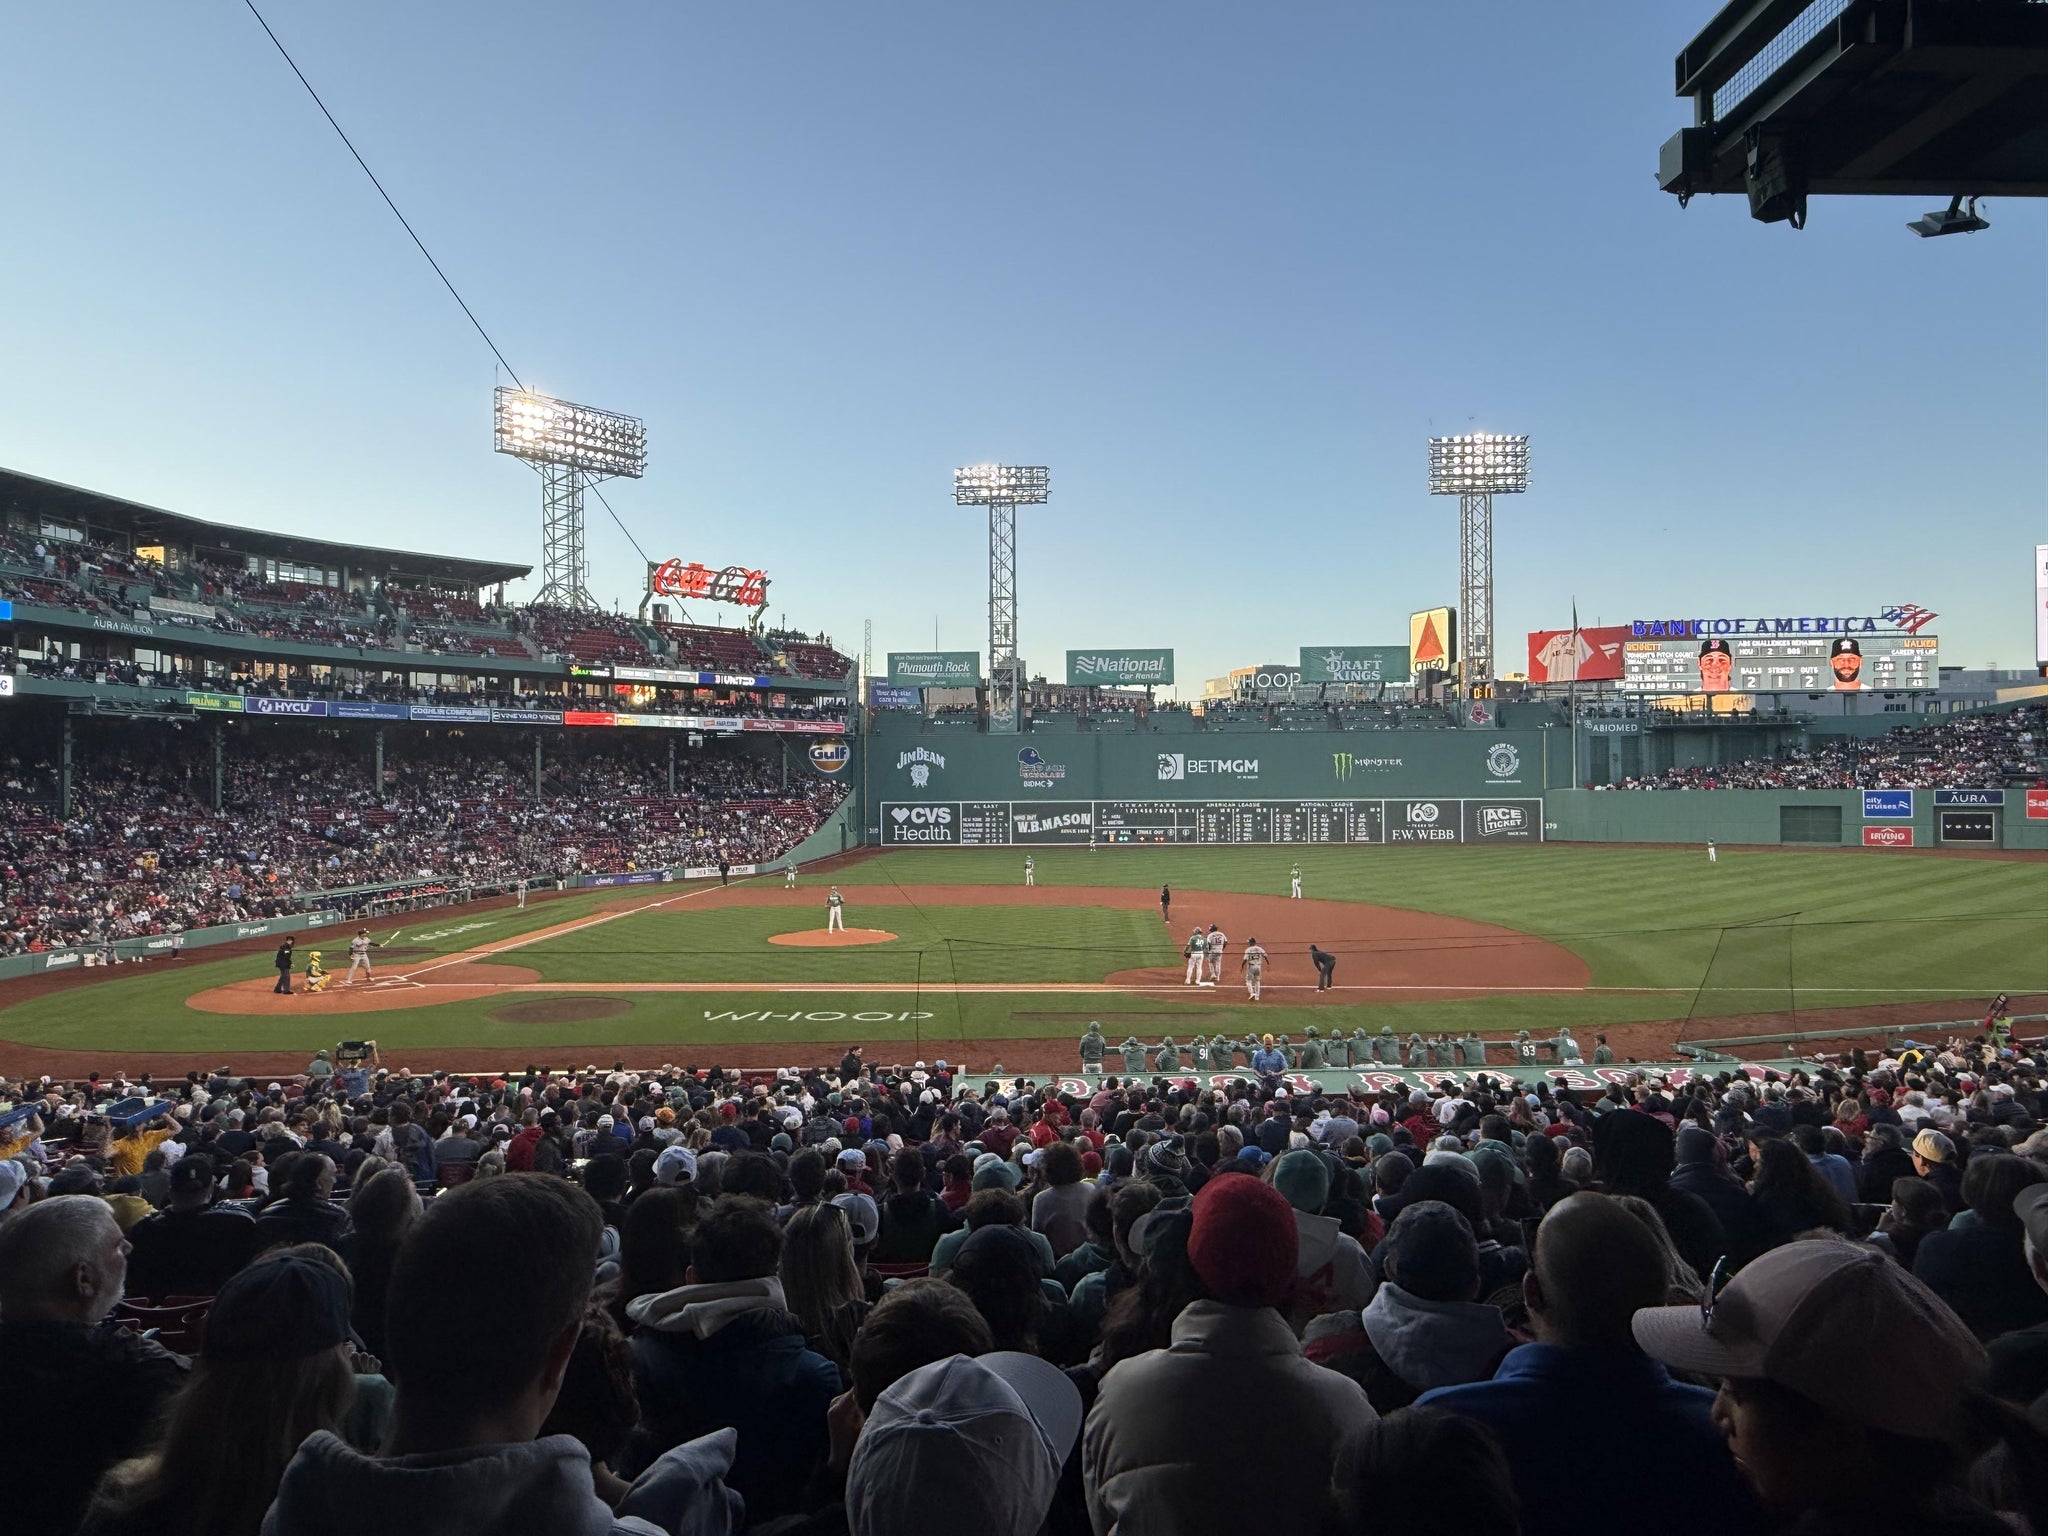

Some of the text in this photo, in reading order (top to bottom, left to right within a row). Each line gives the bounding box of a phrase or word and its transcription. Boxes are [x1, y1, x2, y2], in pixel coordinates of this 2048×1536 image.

[120, 622, 153, 635] PAVILION
[1632, 616, 1876, 635] BANK OF AMERICA
[1903, 640, 1936, 648] WALKER
[897, 662, 970, 674] Plymouth Rock
[1096, 657, 1165, 672] National
[1326, 659, 1382, 672] DRAFT
[1228, 672, 1300, 689] WHOOP
[1333, 670, 1381, 681] KINGS
[723, 678, 756, 686] UNITED
[1747, 676, 1814, 688] 2 1 2
[274, 701, 310, 712] HYCU
[1592, 724, 1638, 732] ABIOMED
[810, 745, 848, 759] Gulf
[896, 746, 946, 770] JIM BEAM
[1187, 758, 1259, 773] BETMGM
[1354, 758, 1403, 767] MONSTER
[1866, 802, 1897, 810] cruises
[910, 807, 951, 824] CVS
[1407, 803, 1439, 822] 160
[1486, 808, 1522, 821] ACE
[1487, 819, 1522, 829] TICKET
[893, 825, 952, 840] Health
[1392, 830, 1455, 840] F.W. WEBB
[703, 1011, 924, 1021] WHOOP
[1199, 1048, 1208, 1060] 91
[1522, 1045, 1536, 1057] 83
